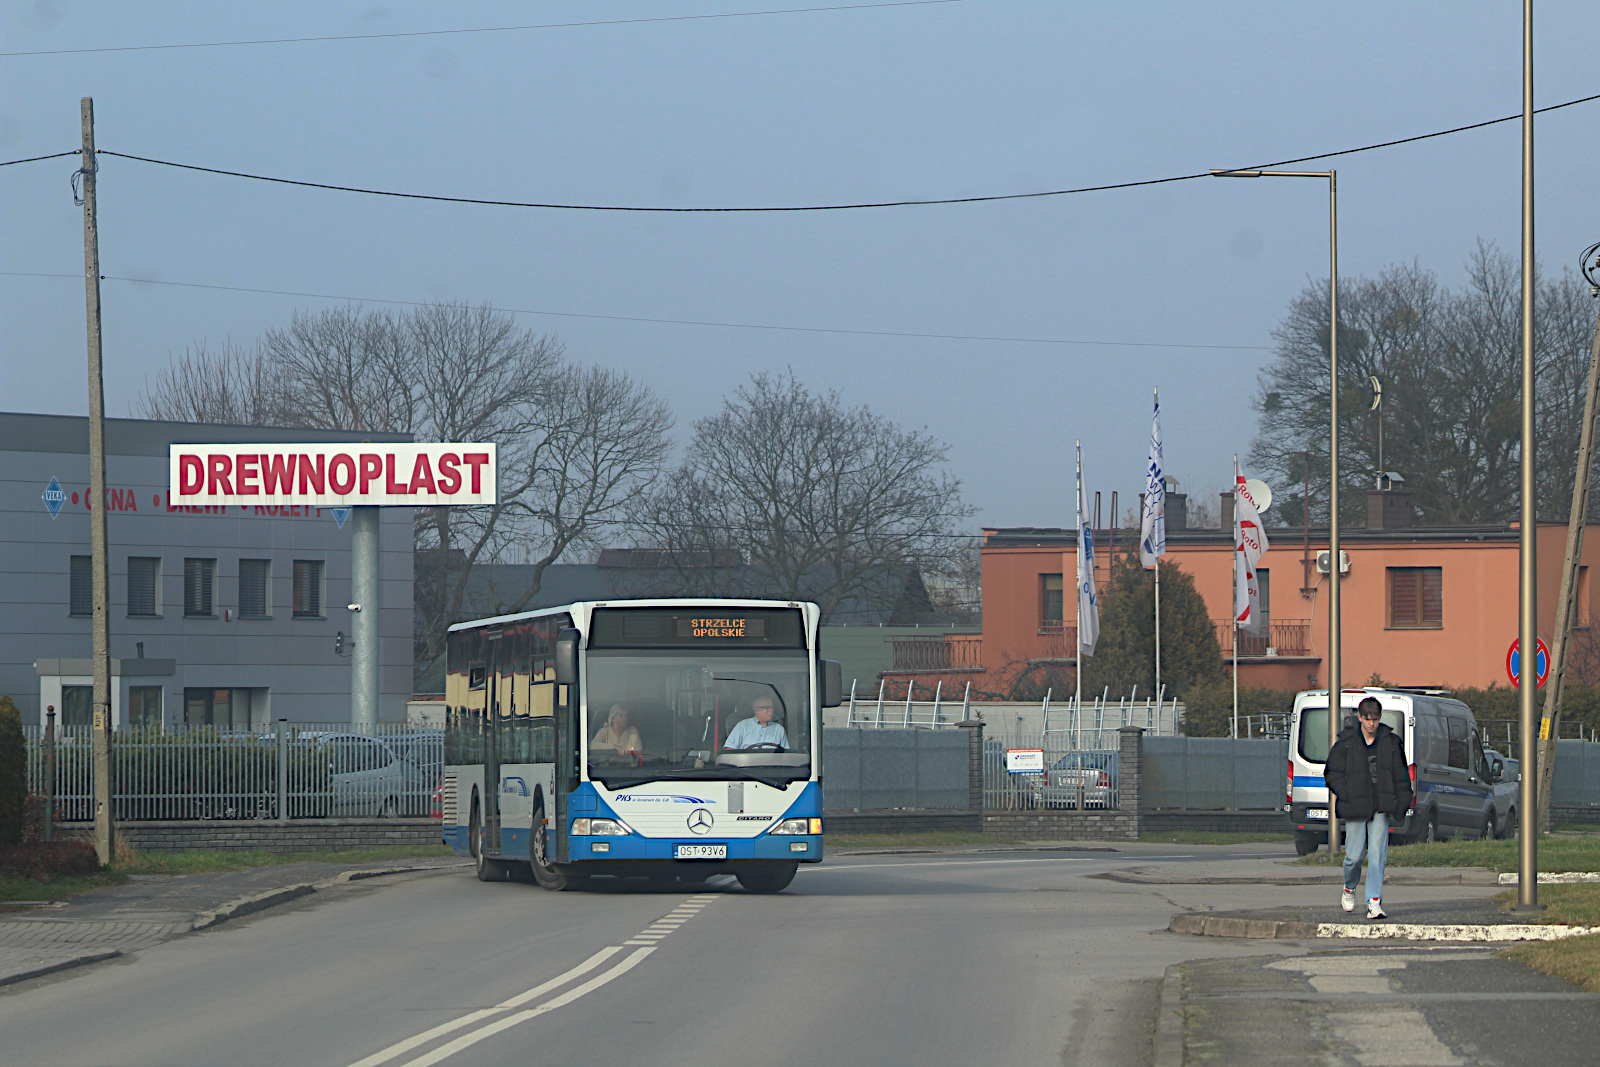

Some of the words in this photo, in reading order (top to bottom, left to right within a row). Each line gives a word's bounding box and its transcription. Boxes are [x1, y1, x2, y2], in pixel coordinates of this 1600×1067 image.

[179, 452, 489, 496] DREWNOPLAST
[45, 491, 63, 501] VEKA
[691, 618, 746, 628] STRZELCE
[693, 628, 745, 637] OPOLSKIE
[615, 794, 632, 802] PKS
[680, 846, 697, 856] OST
[701, 846, 725, 856] 93V6
